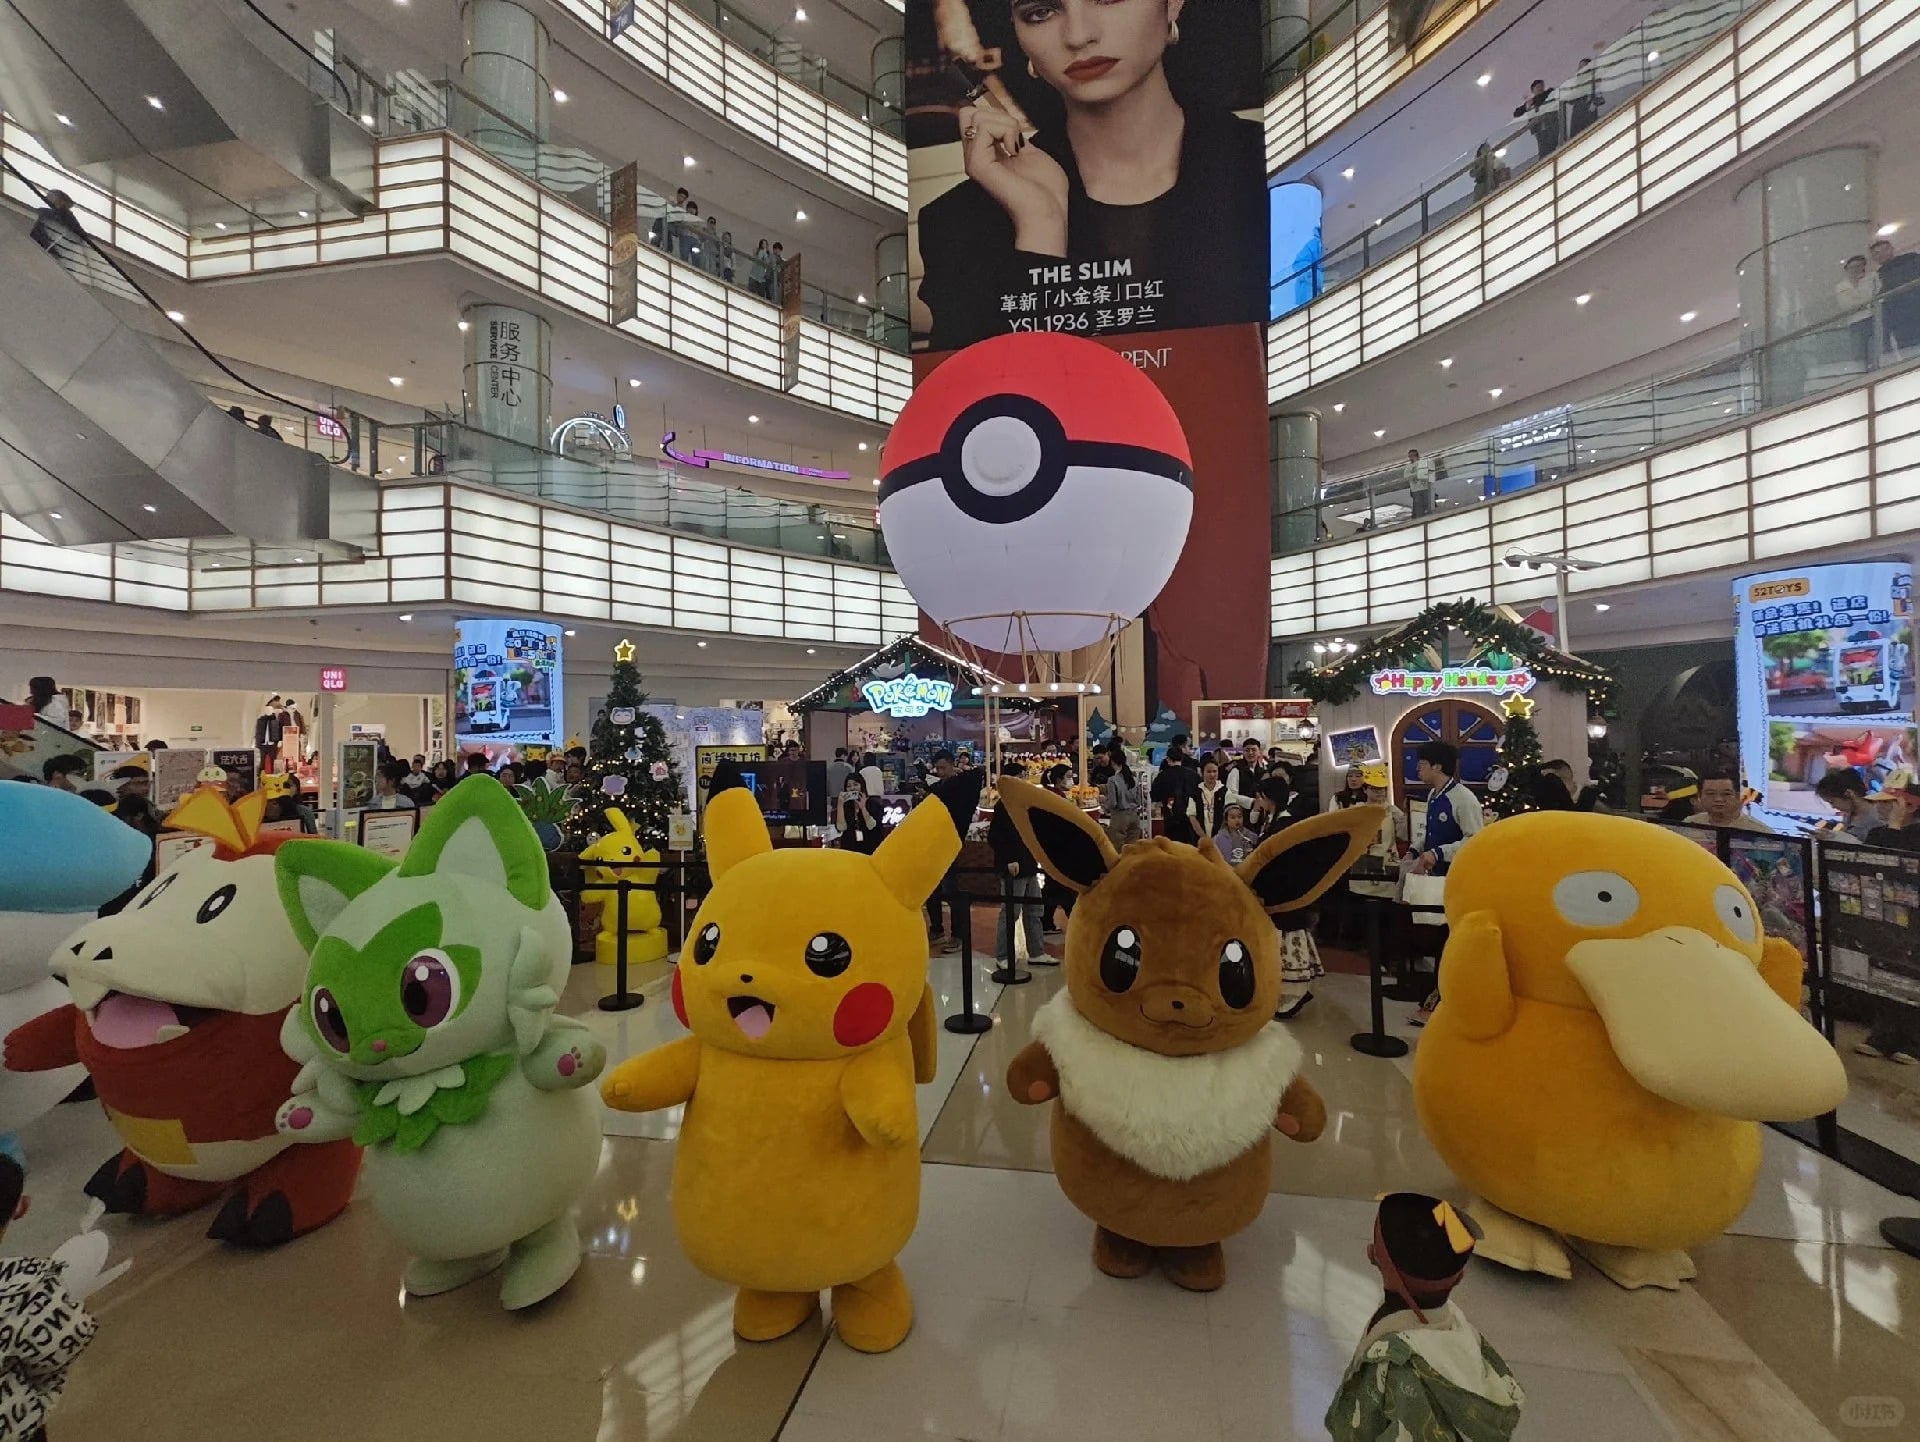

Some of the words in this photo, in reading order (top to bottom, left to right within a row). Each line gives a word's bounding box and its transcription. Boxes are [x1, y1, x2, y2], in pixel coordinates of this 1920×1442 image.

[1028, 265, 1072, 286] THE
[1078, 257, 1133, 281] SLIM
[1000, 279, 1165, 313] 革新「小金条」口红
[1009, 312, 1089, 333] YSL1936
[1096, 305, 1156, 328] 圣罗兰
[490, 320, 498, 359] SERVICE
[500, 321, 522, 407] 服务中心
[490, 365, 499, 399] CENTER
[723, 452, 799, 474] INFORMATION
[1754, 582, 1802, 597] 52TOYS
[323, 671, 342, 679] UNI
[323, 680, 343, 688] QLO
[1391, 673, 1442, 691] Happy
